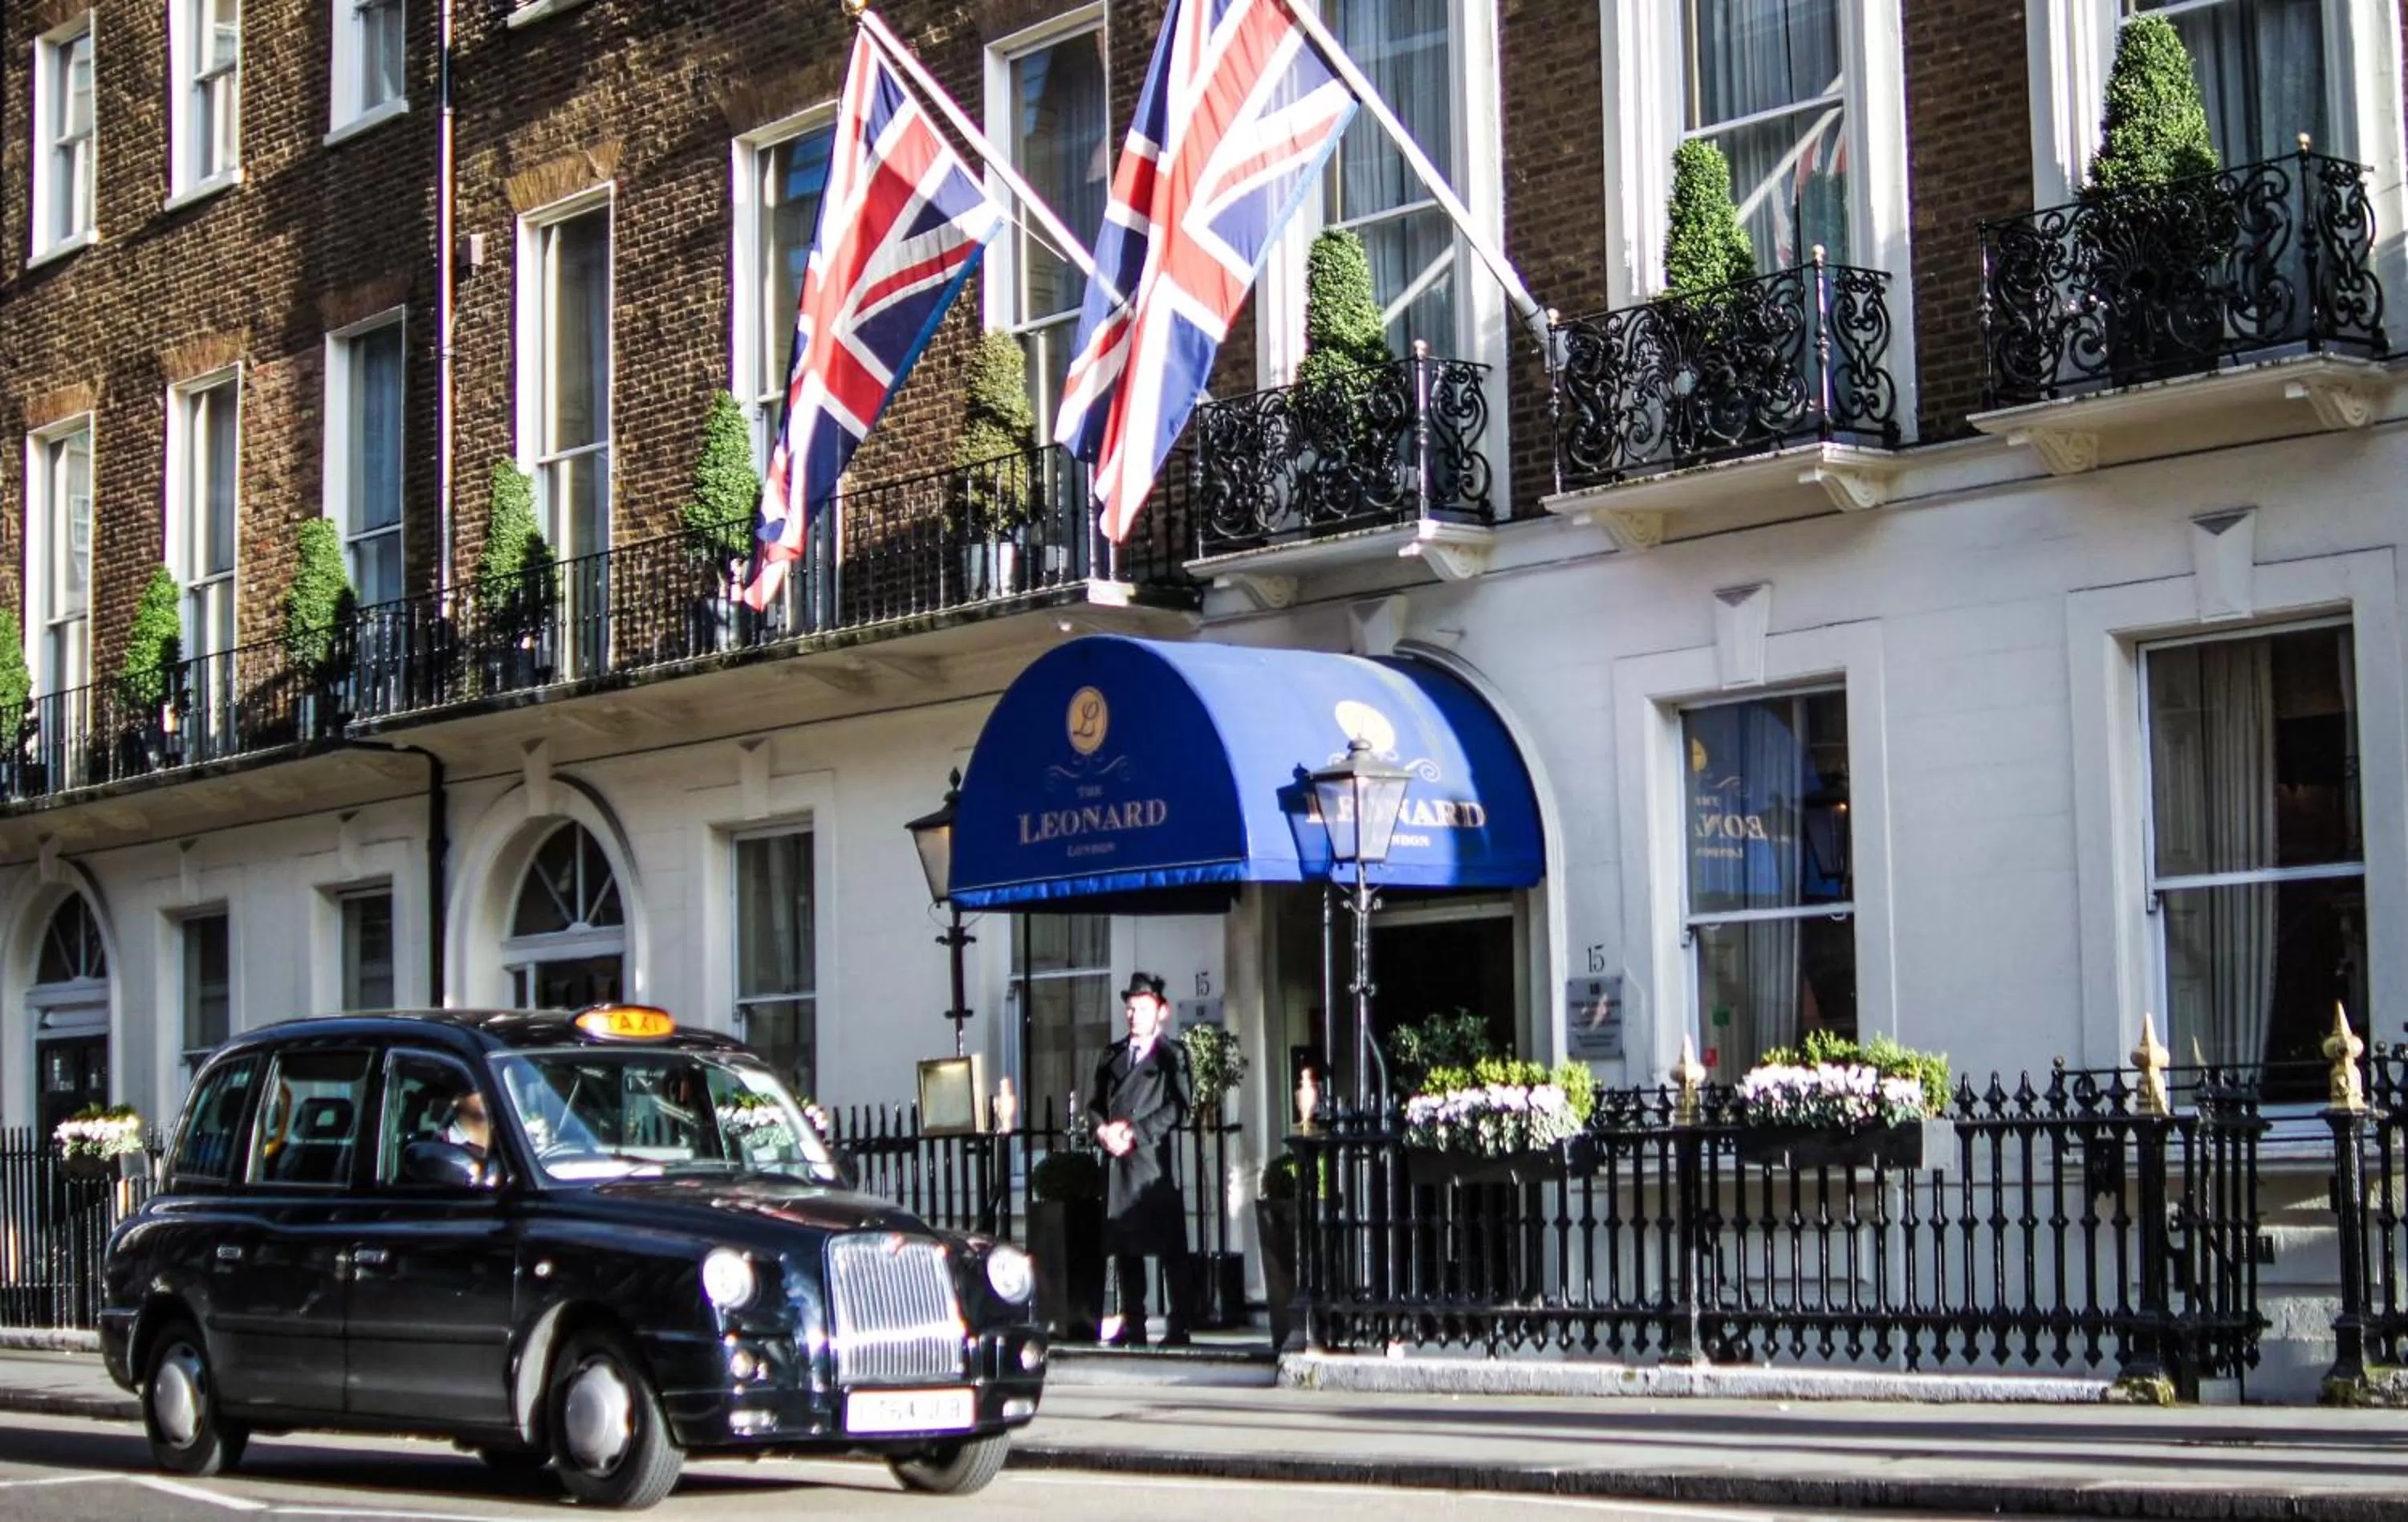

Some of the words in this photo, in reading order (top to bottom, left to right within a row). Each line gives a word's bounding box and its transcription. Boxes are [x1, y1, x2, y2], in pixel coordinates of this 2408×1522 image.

[1017, 799, 1168, 844] LEONARD
[1304, 793, 1486, 828] LENARD
[1587, 944, 1605, 973] 15
[1195, 970, 1210, 997] 15
[607, 1014, 659, 1032] TAXI
